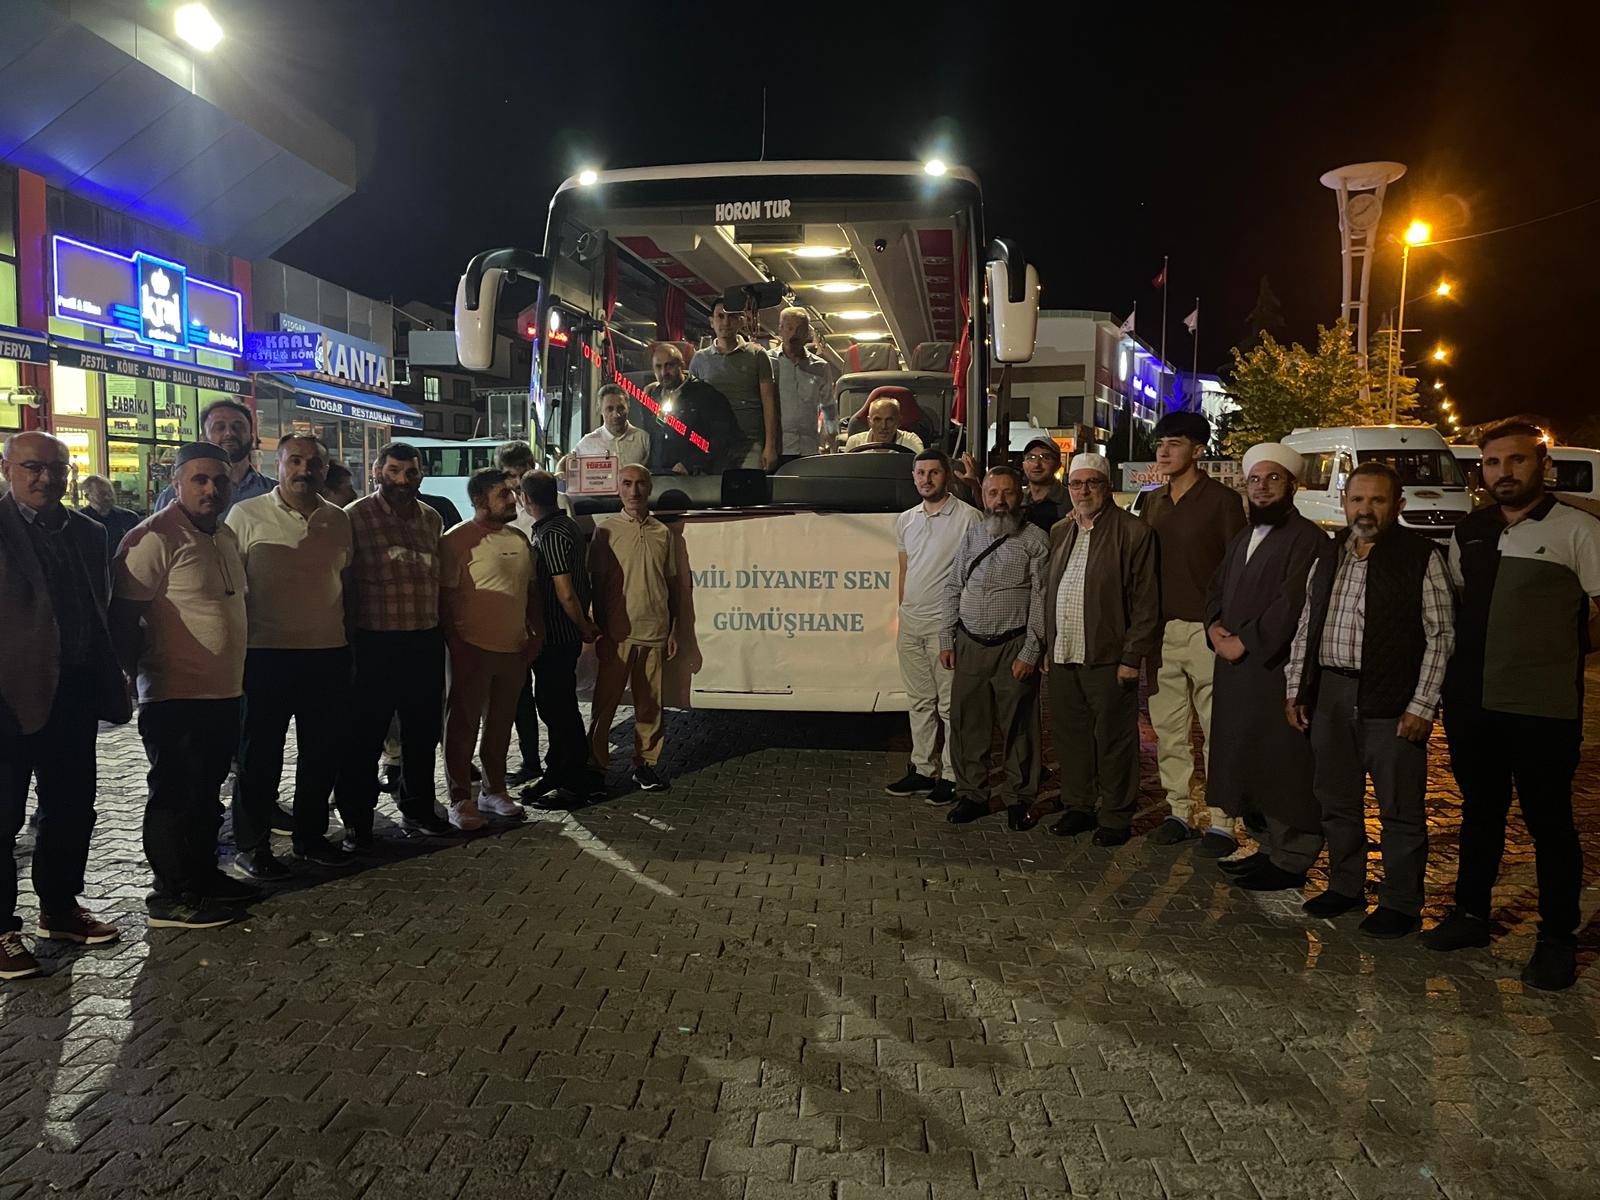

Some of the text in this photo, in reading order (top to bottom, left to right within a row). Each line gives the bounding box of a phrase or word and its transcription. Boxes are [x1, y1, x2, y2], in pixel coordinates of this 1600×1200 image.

[715, 199, 791, 222] HORON TUR
[265, 334, 313, 349] KRAL
[291, 349, 317, 360] KÖM
[326, 340, 390, 390] KANTA
[112, 394, 187, 421] FABRİKA SATIŞ
[309, 397, 344, 414] OTOGAR
[351, 406, 396, 424] RESTAURANT
[735, 564, 838, 590] DİYANET
[843, 570, 891, 590] SEN
[713, 606, 864, 639] GÜMÜŞHANE
